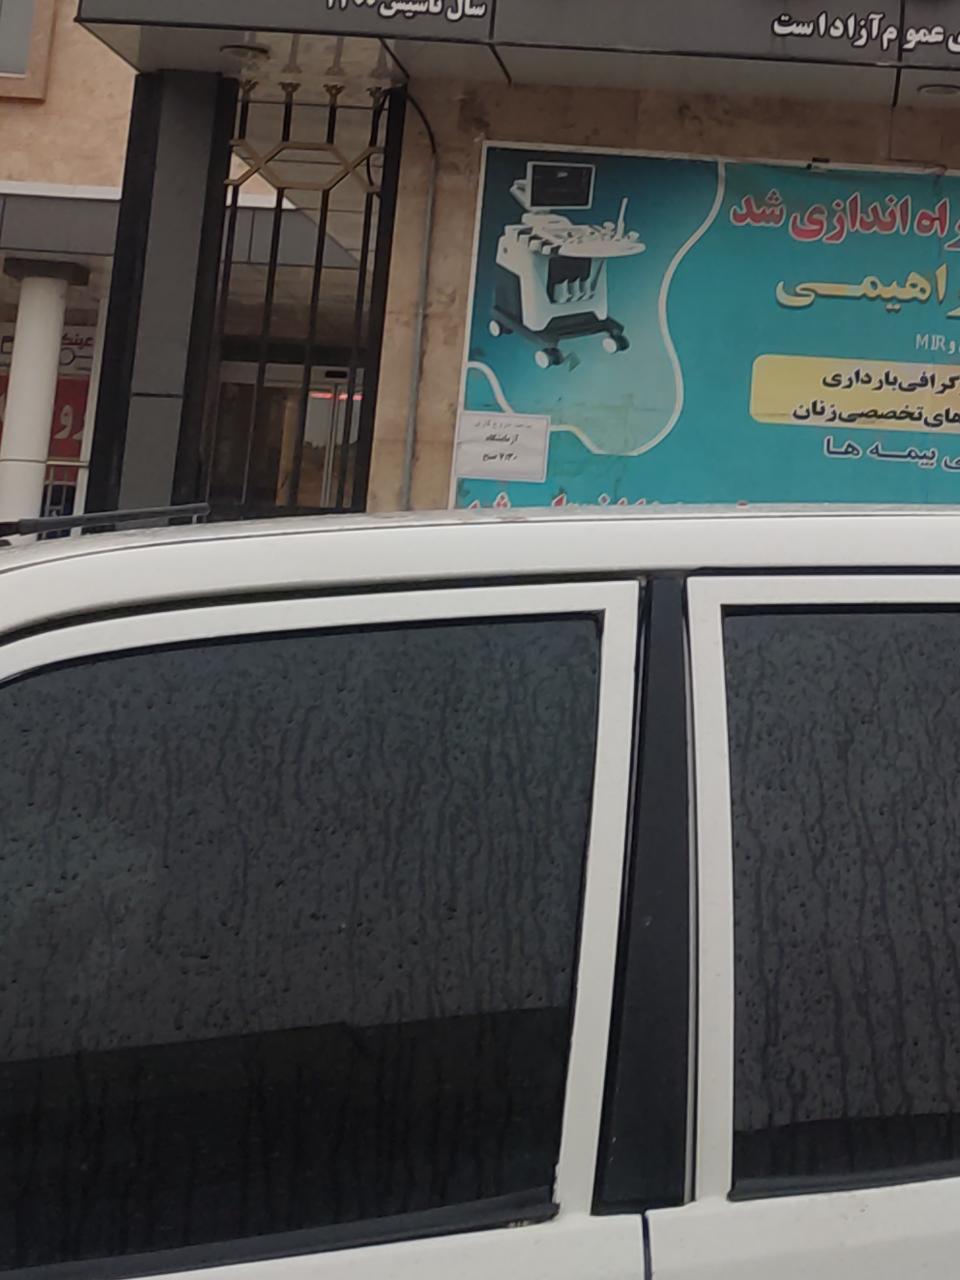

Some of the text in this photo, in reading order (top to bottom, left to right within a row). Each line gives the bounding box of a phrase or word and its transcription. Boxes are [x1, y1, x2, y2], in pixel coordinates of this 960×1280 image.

[773, 13, 826, 37] است
[829, 13, 883, 47] آزاد
[882, 24, 944, 50] عموم
[730, 188, 786, 226] شد
[789, 191, 911, 244] اندازی
[948, 340, 956, 354] و
[822, 369, 898, 392] بارداری
[792, 399, 837, 422] زنان
[838, 404, 923, 424] تخصصی
[824, 435, 861, 459] ها
[867, 440, 938, 468] بیمه
